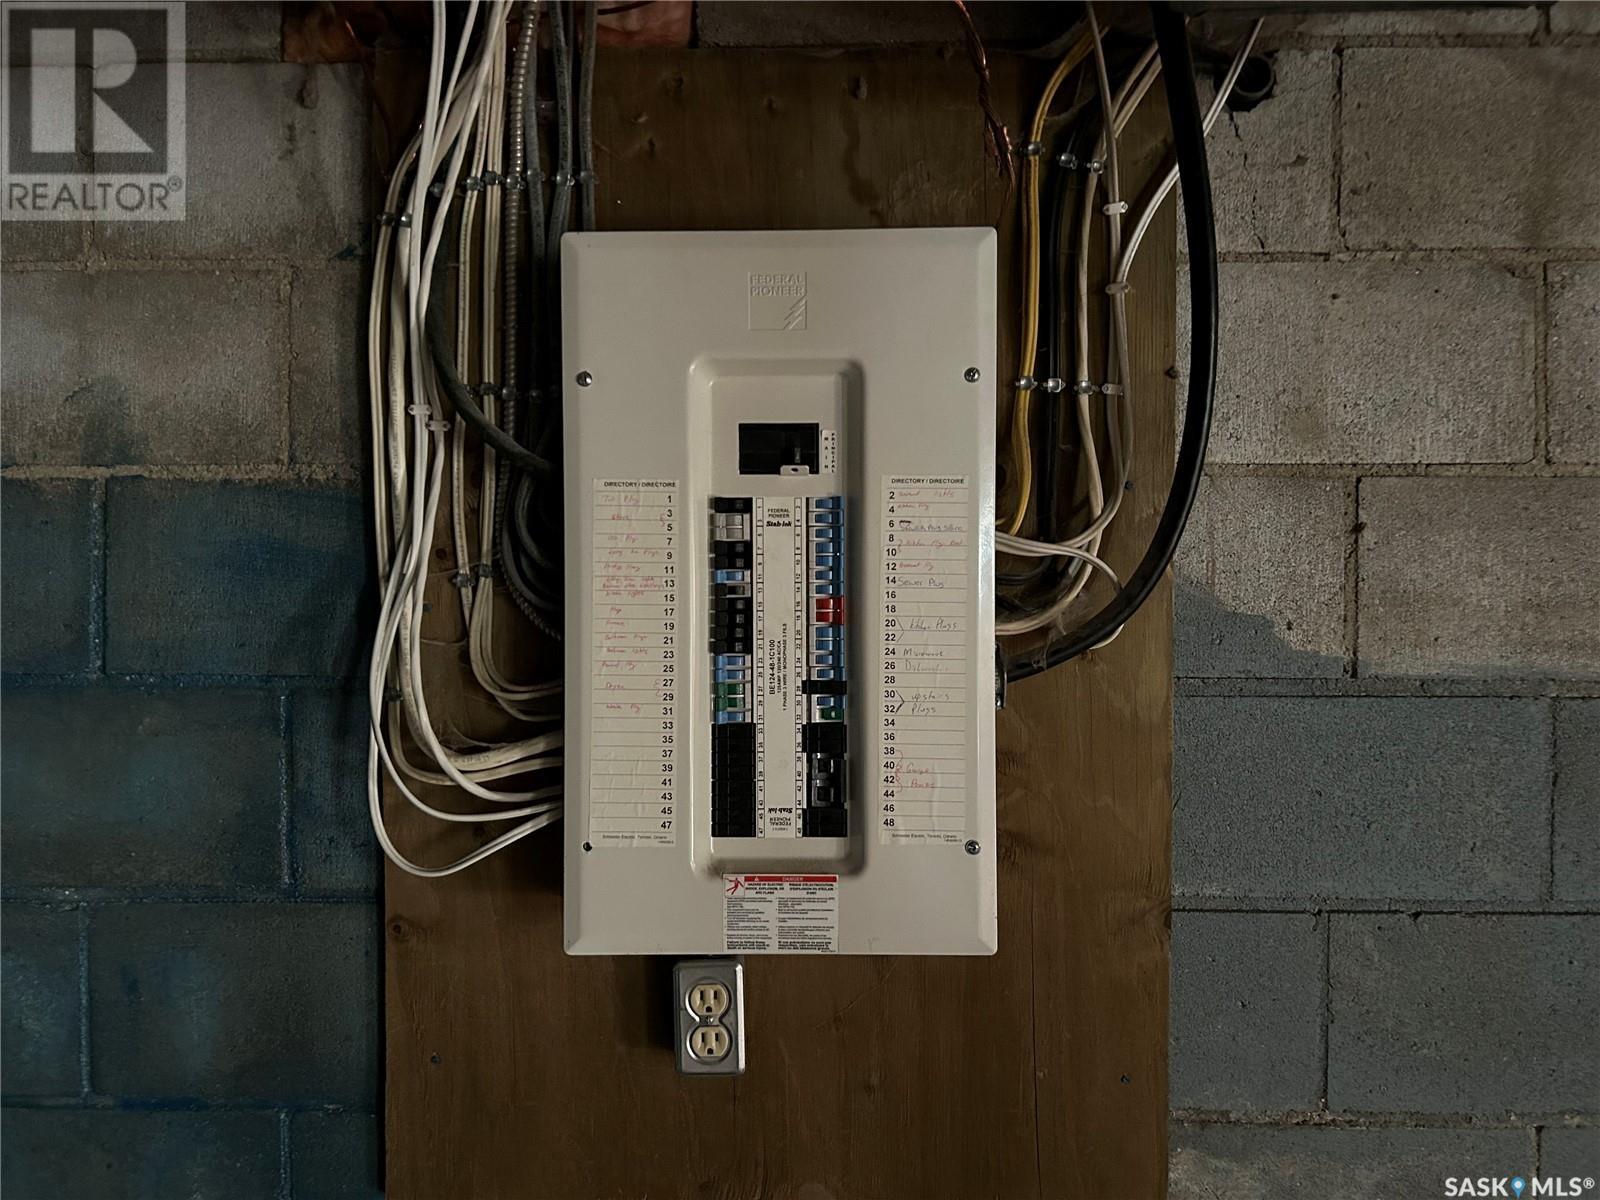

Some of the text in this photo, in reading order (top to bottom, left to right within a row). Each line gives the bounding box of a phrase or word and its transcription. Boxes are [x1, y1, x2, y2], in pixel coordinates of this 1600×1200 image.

[750, 274, 803, 284] FEDERAL
[750, 286, 804, 296] PIONEER
[667, 495, 672, 504] 1
[889, 491, 895, 500] 2
[666, 509, 673, 517] 3
[888, 505, 895, 514] 4
[666, 523, 673, 532] 5
[888, 519, 895, 528] 6
[666, 537, 673, 546] 7
[888, 534, 895, 542] 8
[666, 551, 673, 560] 9
[886, 548, 897, 557] 10
[664, 565, 674, 574] 11
[886, 562, 897, 571] 12
[664, 579, 675, 588] 13
[886, 576, 897, 585] 14
[898, 576, 923, 587] Sewer
[663, 593, 675, 602] 15
[885, 590, 897, 599] 16
[663, 607, 675, 616] 17
[885, 604, 897, 613] 18
[663, 622, 675, 631] 19
[884, 619, 896, 627] 20
[663, 636, 674, 645] 21
[884, 633, 896, 641] 22
[663, 650, 675, 659] 23
[884, 647, 896, 656] 24
[662, 664, 674, 673] 25
[884, 661, 896, 670] 26
[662, 678, 674, 687] 27
[884, 675, 896, 684] 28
[662, 693, 674, 701] 29
[884, 690, 896, 698] 30
[662, 707, 673, 715] 31
[883, 704, 896, 713] 32
[662, 721, 674, 730] 33
[883, 718, 896, 727] 34
[662, 735, 674, 744] 35
[883, 732, 896, 741] 36
[662, 749, 673, 758] 37
[883, 746, 895, 755] 38
[661, 764, 673, 772] 39
[883, 761, 895, 769] 40
[661, 778, 672, 787] 41
[883, 775, 895, 784] 42
[660, 792, 673, 801] 43
[883, 789, 895, 798] 44
[660, 806, 673, 815] 45
[883, 804, 895, 812] 46
[660, 821, 673, 829] 47
[883, 818, 895, 827] 48
